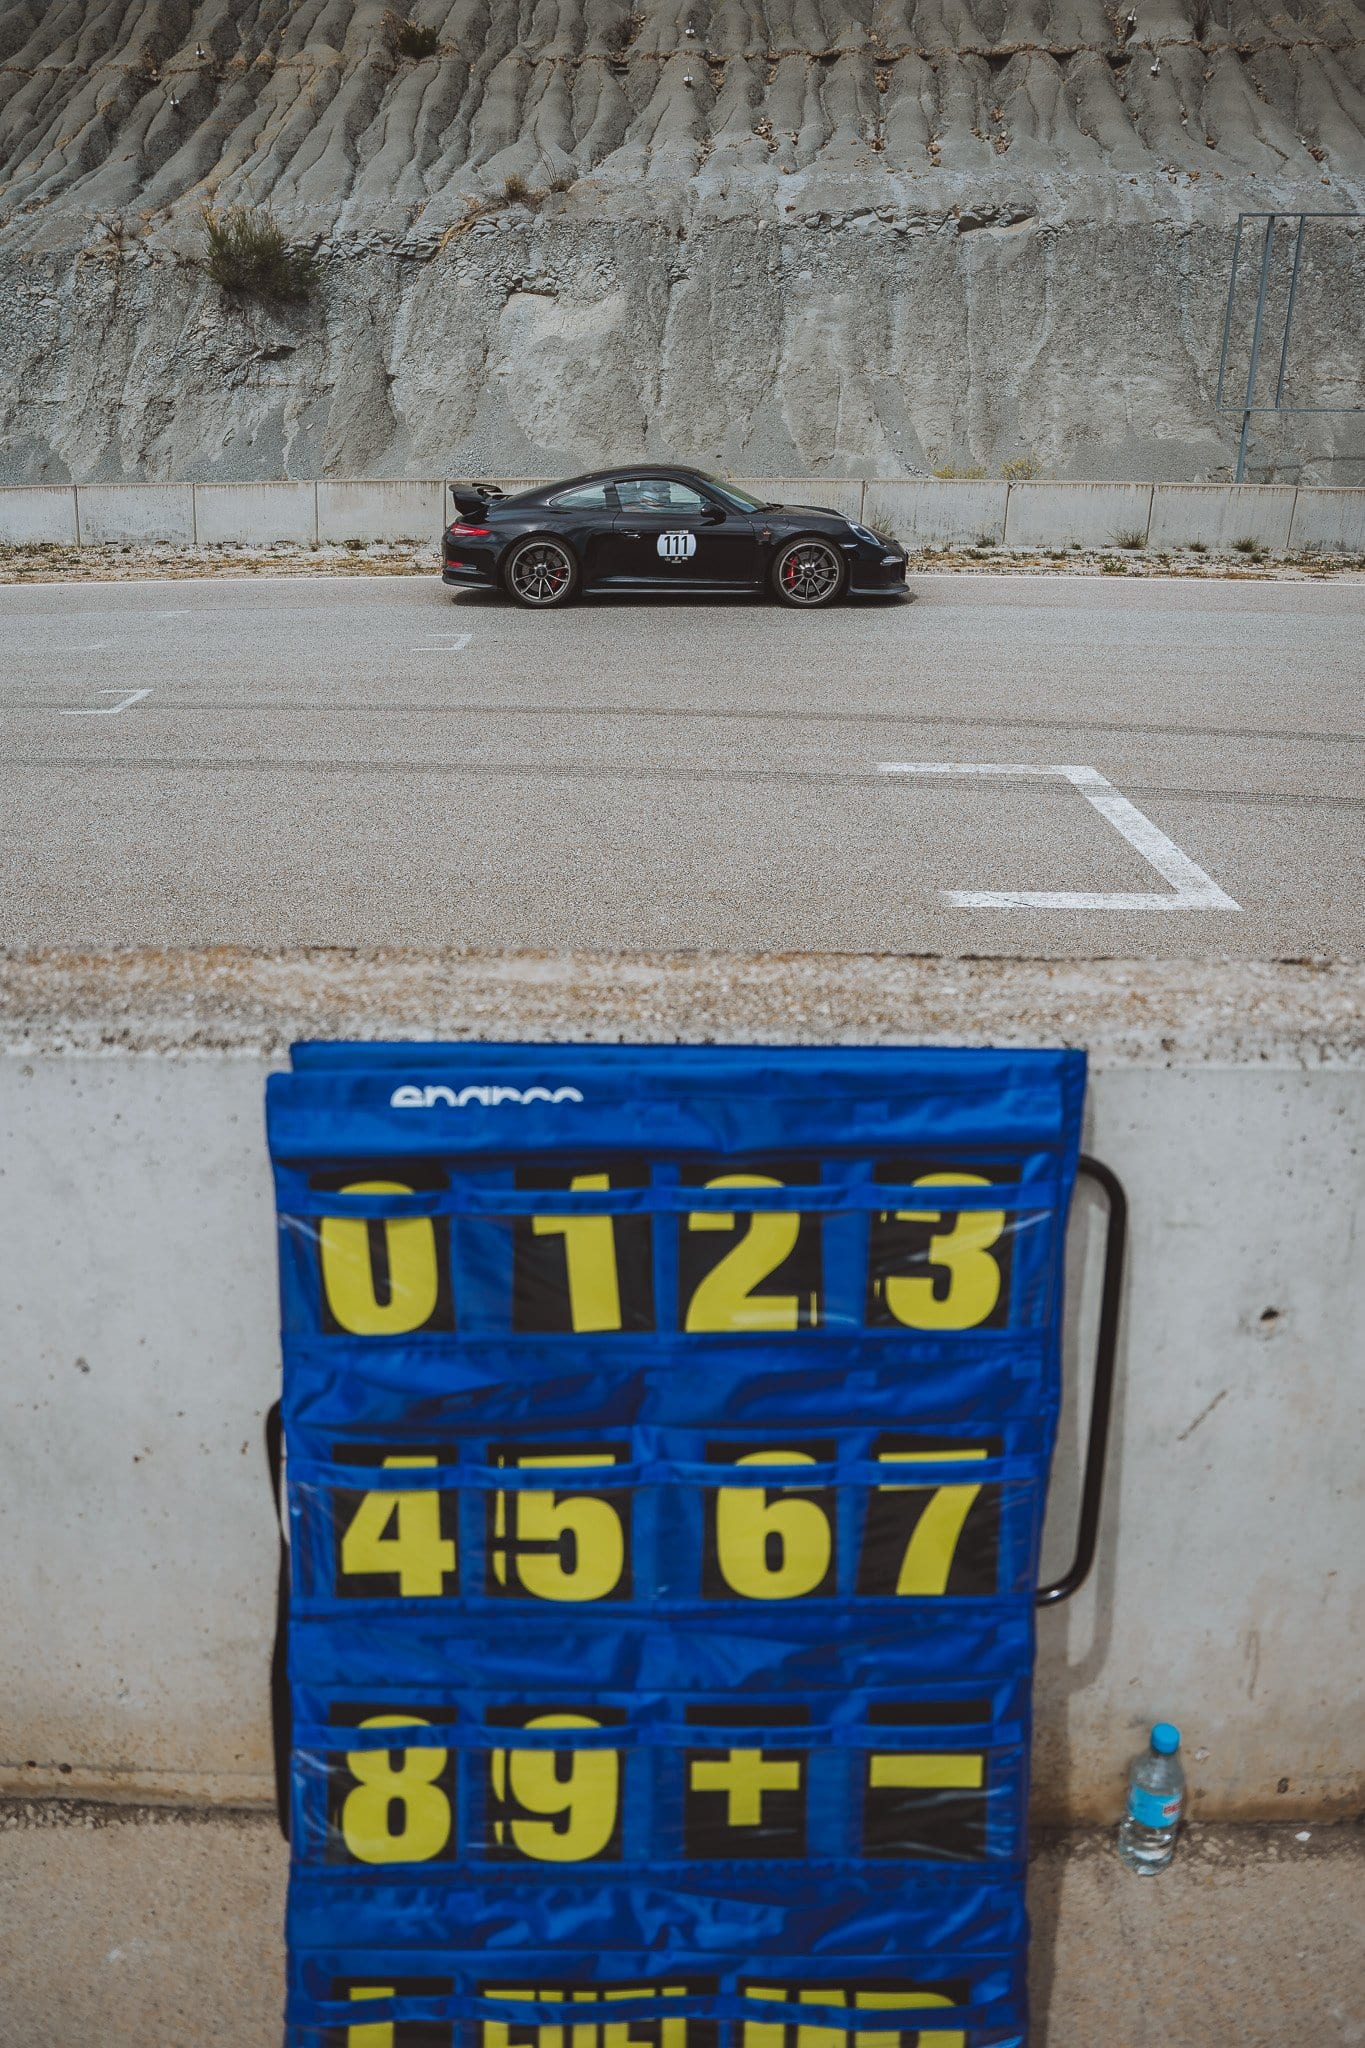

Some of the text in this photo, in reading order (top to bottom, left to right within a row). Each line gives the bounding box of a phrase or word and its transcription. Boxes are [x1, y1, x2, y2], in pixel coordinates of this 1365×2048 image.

[664, 535, 688, 555] 111
[320, 1172, 1006, 1336] 0 1 2 3
[341, 1448, 988, 1602] 4 5 6 7
[342, 1714, 452, 1864] 8
[509, 1713, 620, 1862] 9
